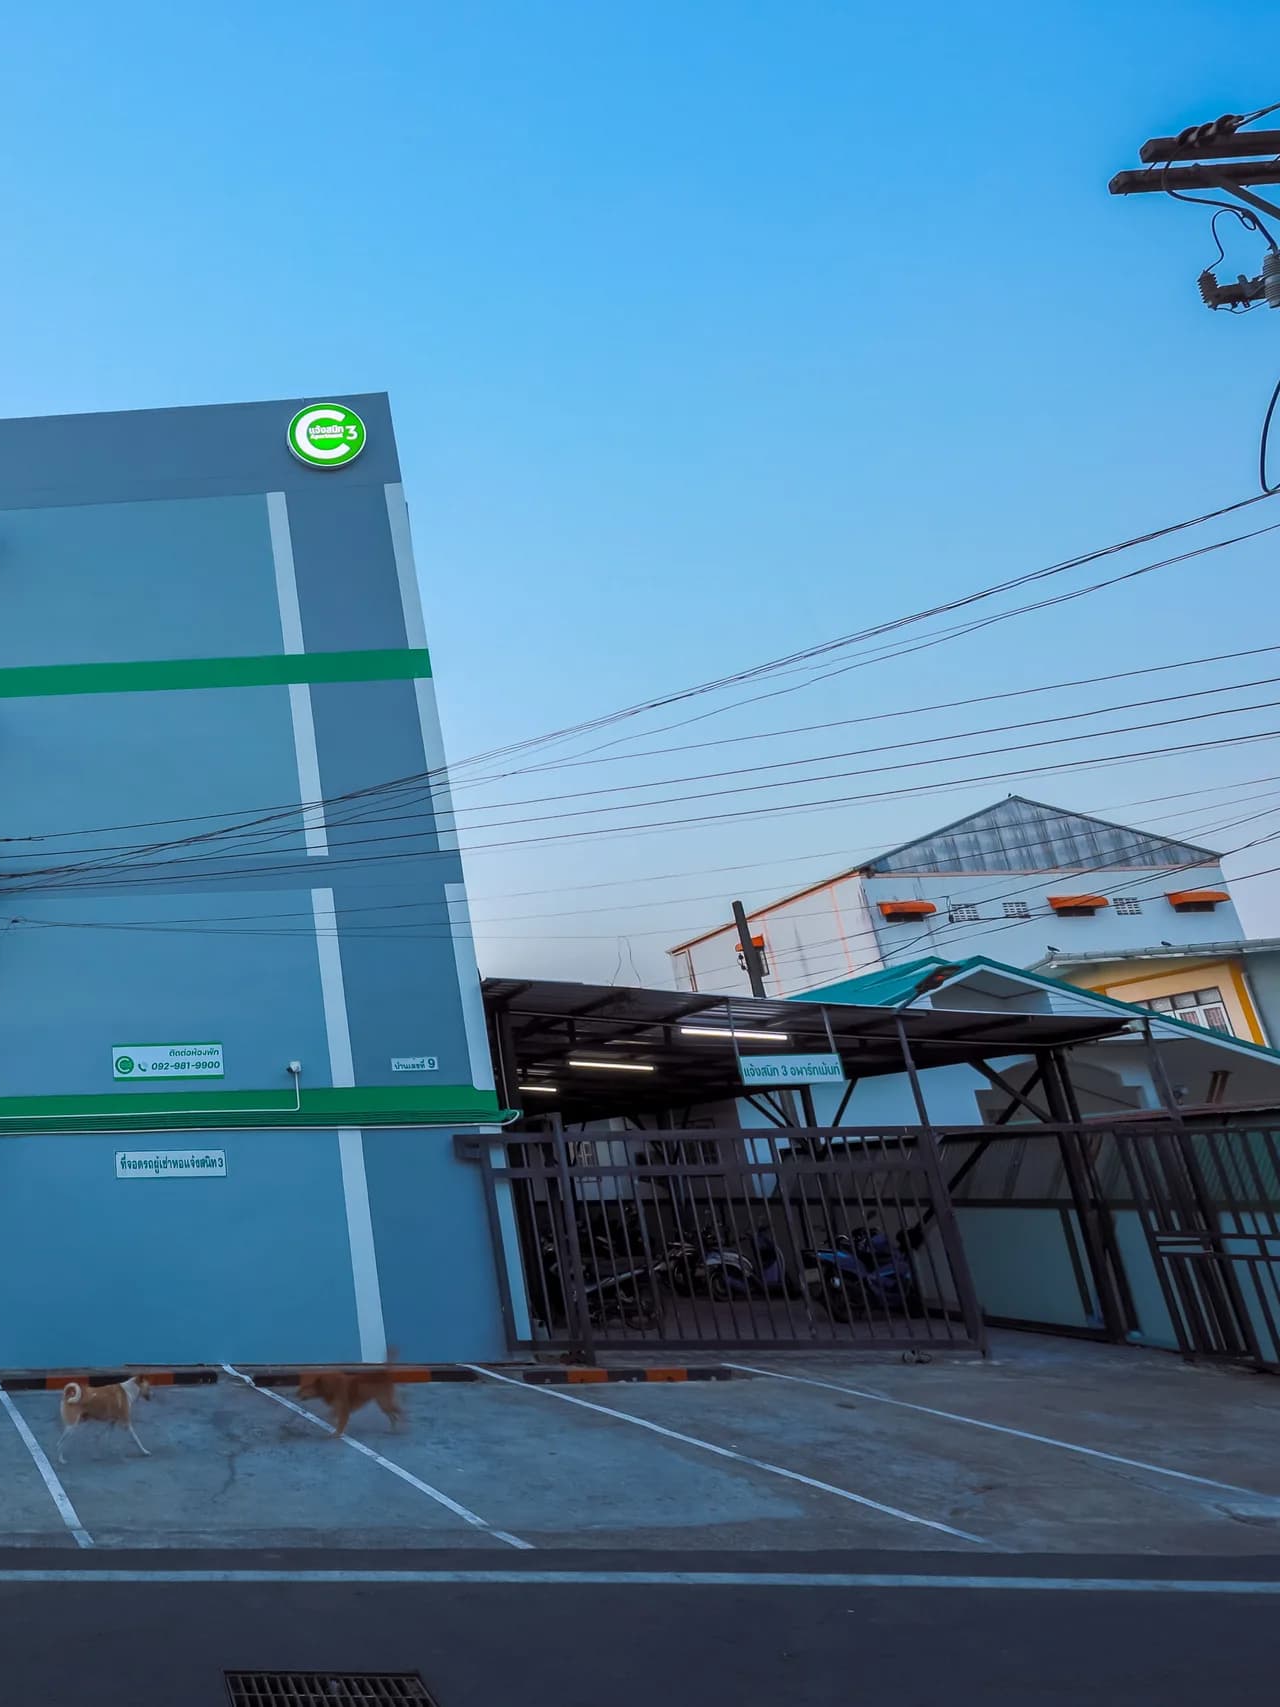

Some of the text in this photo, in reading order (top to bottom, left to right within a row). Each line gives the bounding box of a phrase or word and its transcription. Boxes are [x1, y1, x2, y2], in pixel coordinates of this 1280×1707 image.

[345, 425, 359, 440] 3
[151, 1060, 221, 1071] 092-981-9900
[427, 1058, 436, 1068] 9
[743, 1064, 779, 1077] แจ้งสนิท
[781, 1065, 788, 1077] 3
